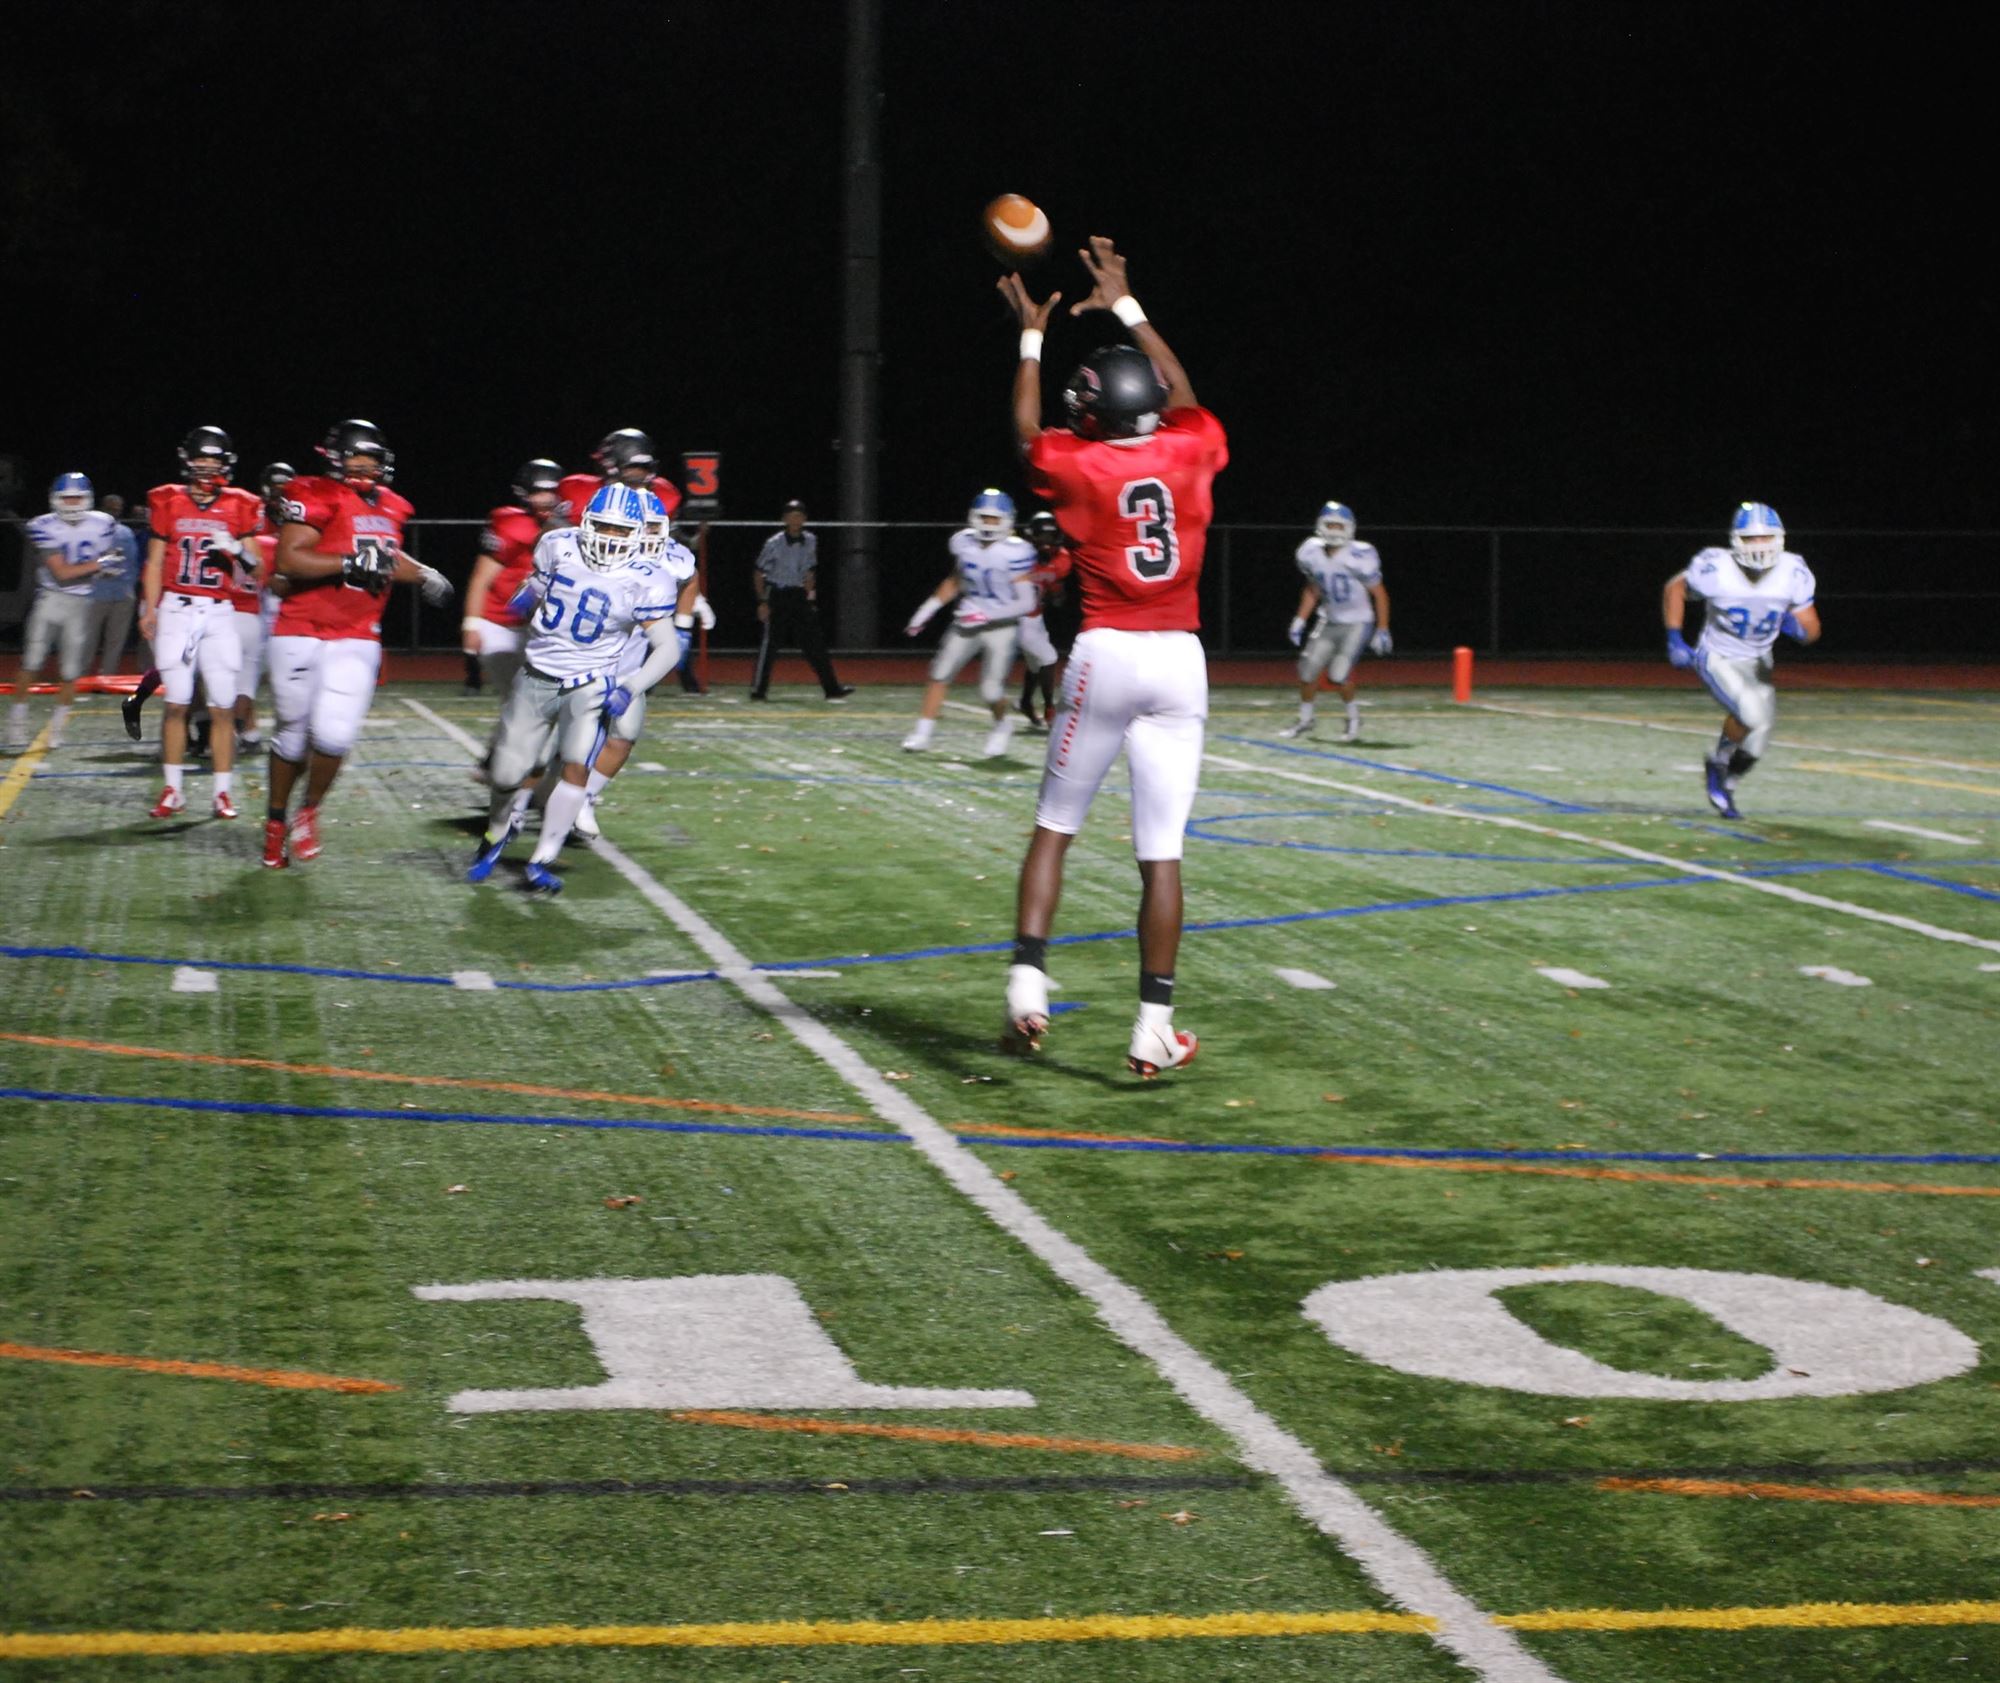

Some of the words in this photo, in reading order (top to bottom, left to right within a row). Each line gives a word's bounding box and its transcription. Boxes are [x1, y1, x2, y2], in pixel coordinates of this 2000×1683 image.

[687, 458, 718, 495] 3
[1118, 477, 1180, 582] 3
[176, 535, 224, 588] 12
[540, 571, 611, 644] 58
